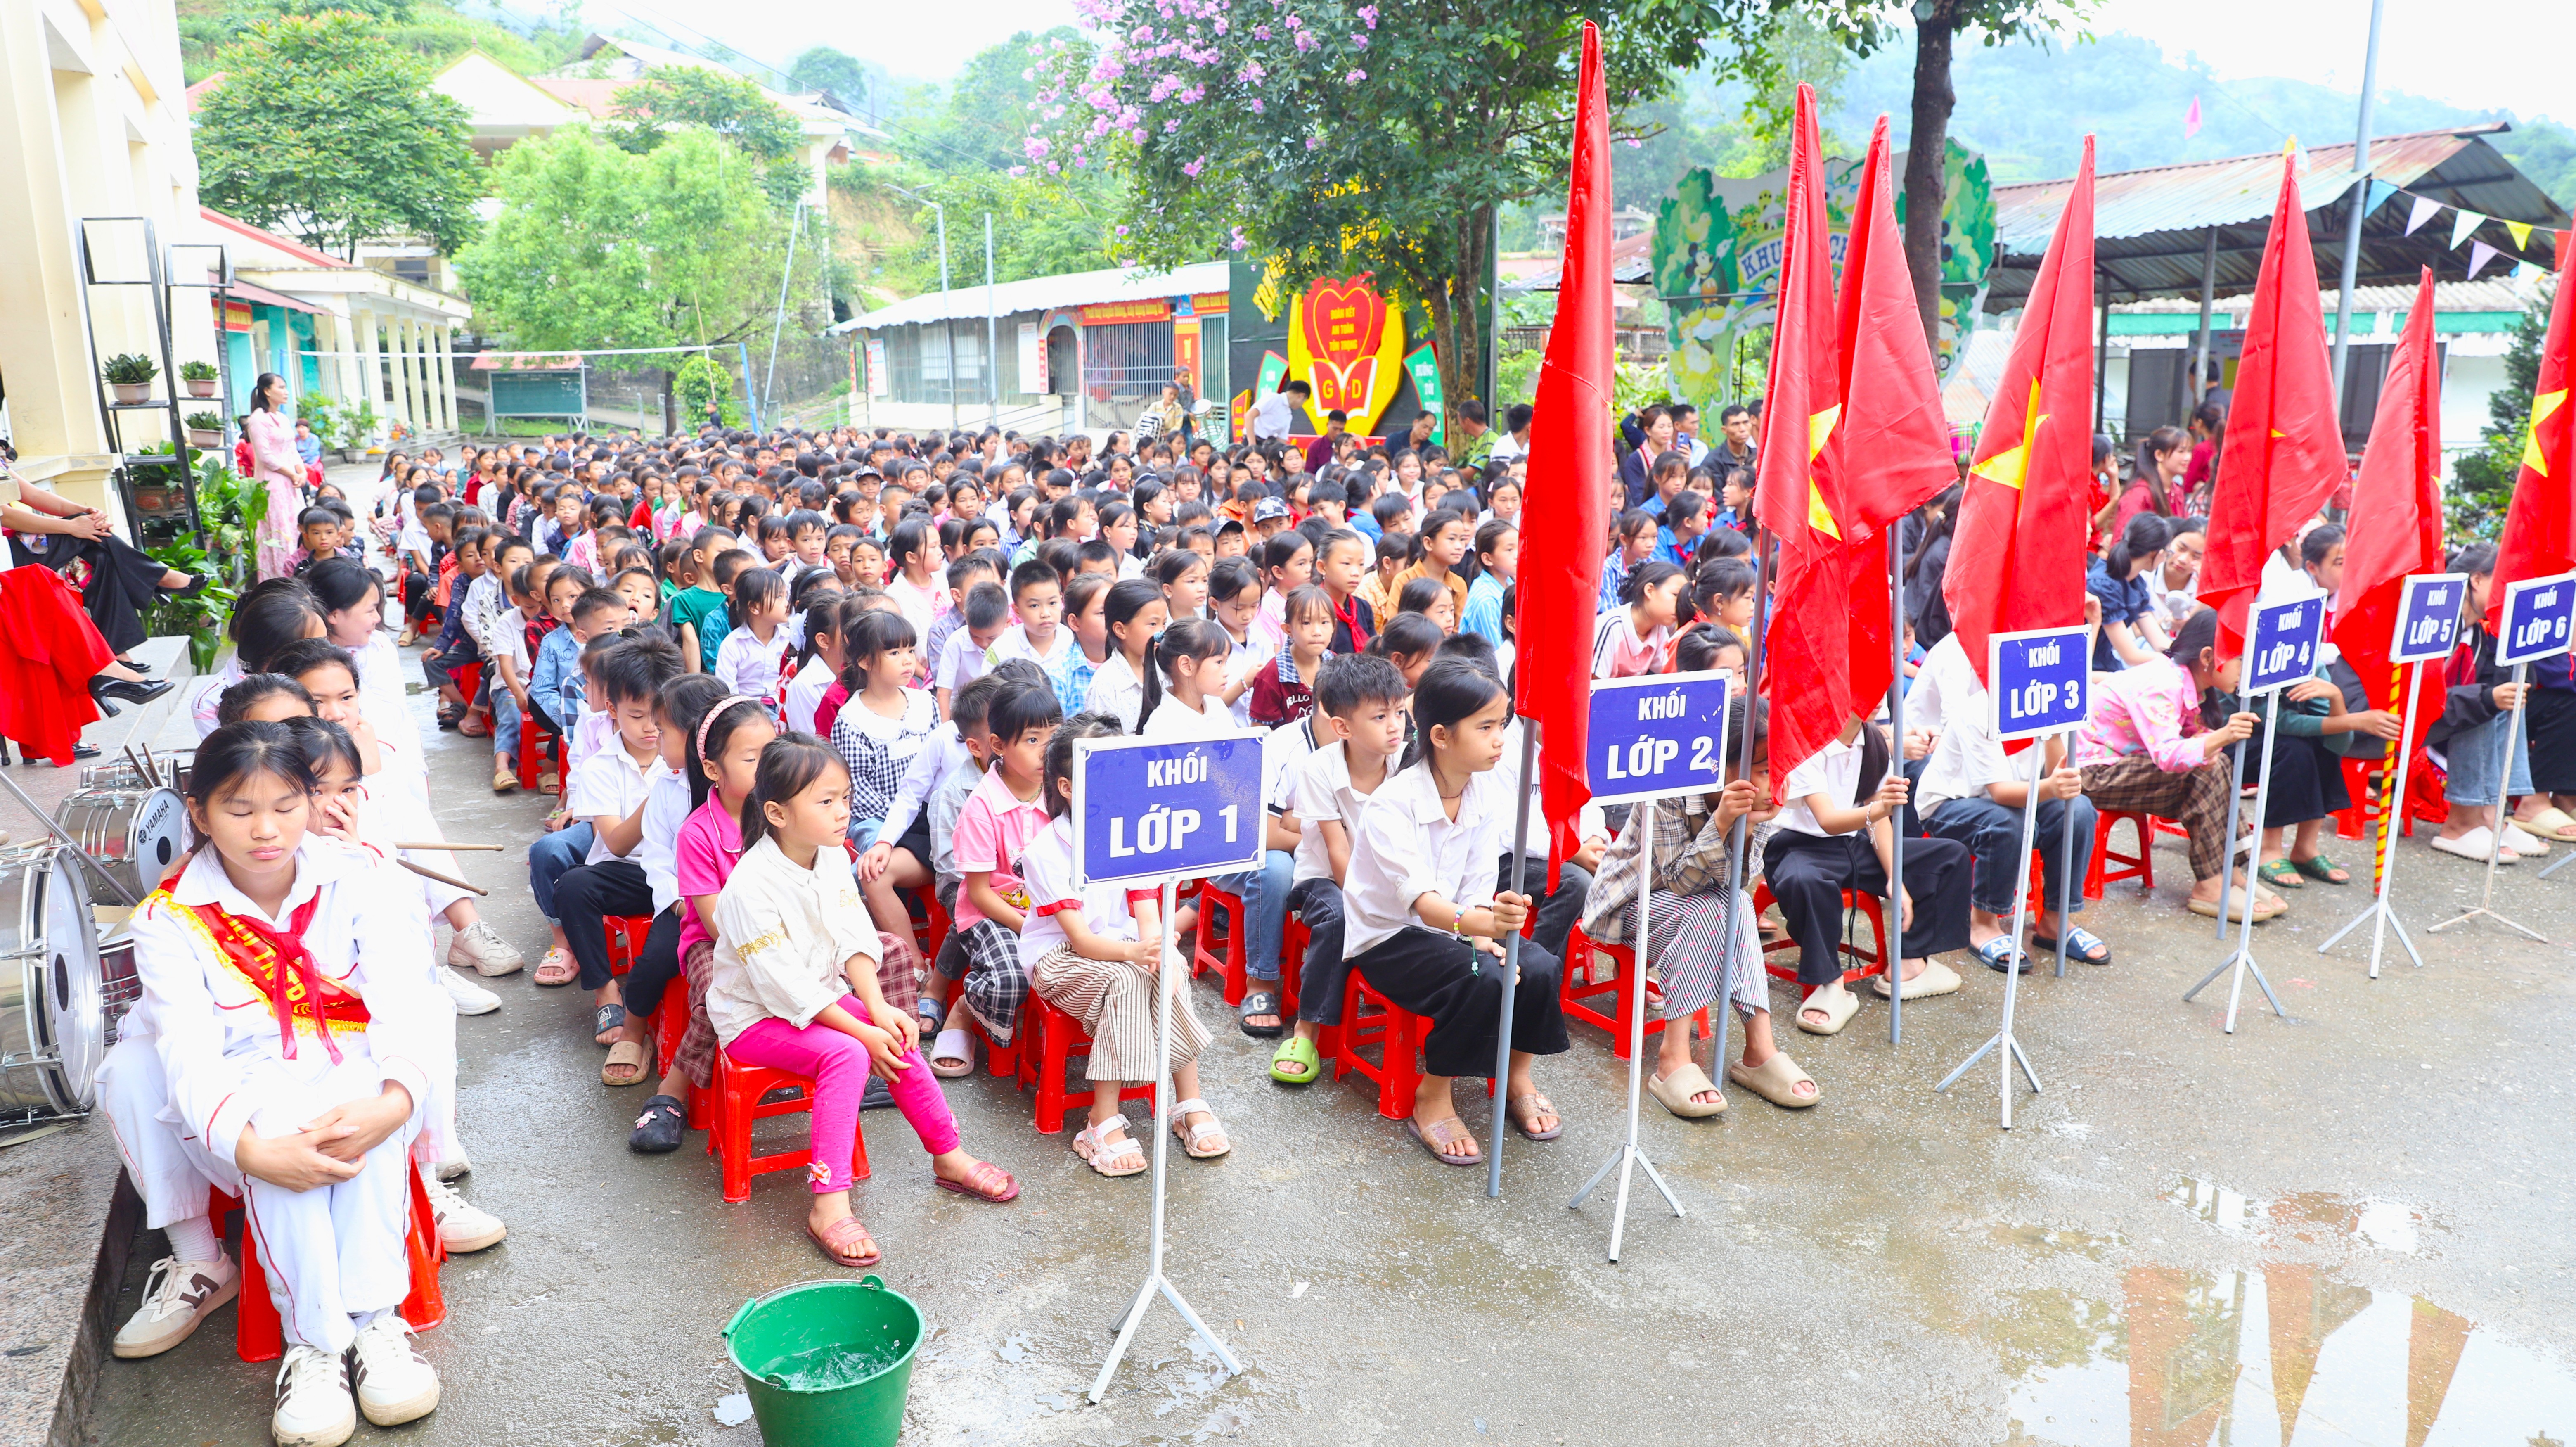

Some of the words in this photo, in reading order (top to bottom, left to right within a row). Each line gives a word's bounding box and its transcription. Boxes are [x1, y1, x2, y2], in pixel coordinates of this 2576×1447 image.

[1741, 240, 1783, 280] KHU
[1322, 379, 1334, 399] G
[2427, 584, 2448, 606] KHỐI
[2533, 585, 2558, 610] KHỐI
[2278, 603, 2302, 632] KHỐI
[2408, 615, 2439, 645] LỚP
[2440, 619, 2452, 643] 5
[2516, 617, 2552, 648] LỚP
[2554, 616, 2567, 639] 6
[2028, 638, 2060, 668] KHỐI
[2257, 642, 2294, 676] LỚP
[2298, 641, 2310, 666] 4
[1638, 687, 1686, 721] KHỐI
[2010, 679, 2057, 719] LỚP
[2064, 680, 2079, 710] 3
[1147, 747, 1208, 788] KHỐI
[1607, 734, 1679, 780] LỚP
[1689, 736, 1713, 771] 2
[145, 799, 170, 833] YAMAHA
[1110, 804, 1201, 858] LỚP
[1219, 804, 1238, 843] 1
[1252, 994, 1267, 1011] G
